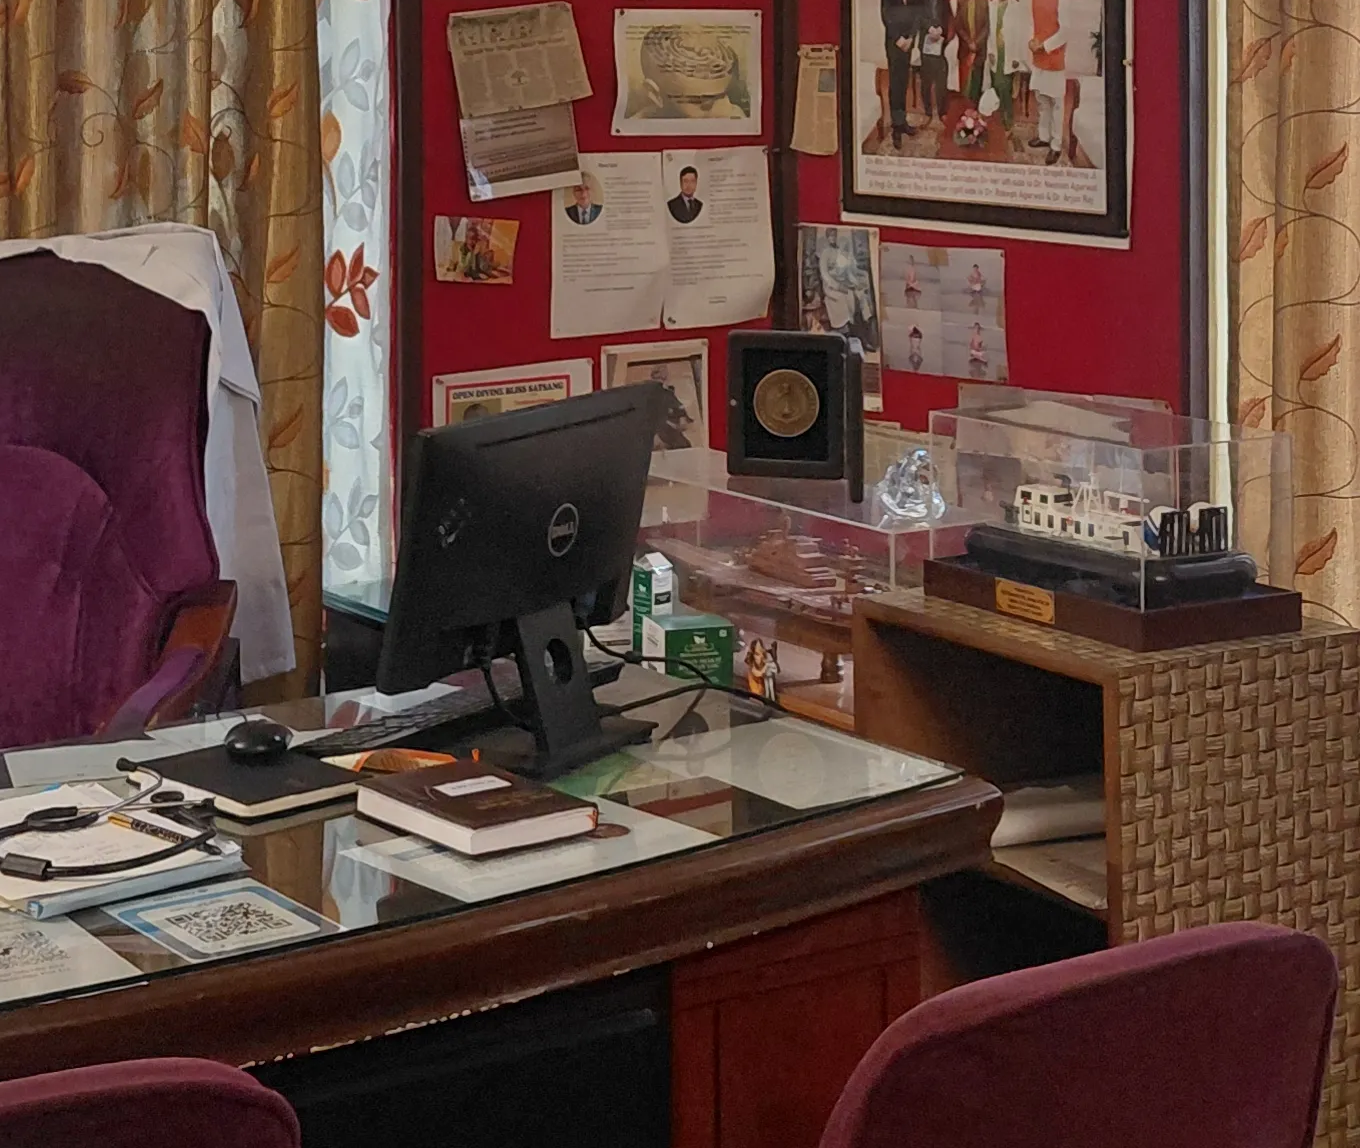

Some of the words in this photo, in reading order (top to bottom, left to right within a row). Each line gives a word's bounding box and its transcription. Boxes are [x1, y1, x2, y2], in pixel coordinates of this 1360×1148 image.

[452, 390, 474, 400] OPEN
[476, 387, 504, 397] DIVINE
[528, 381, 564, 393] SATSANG
